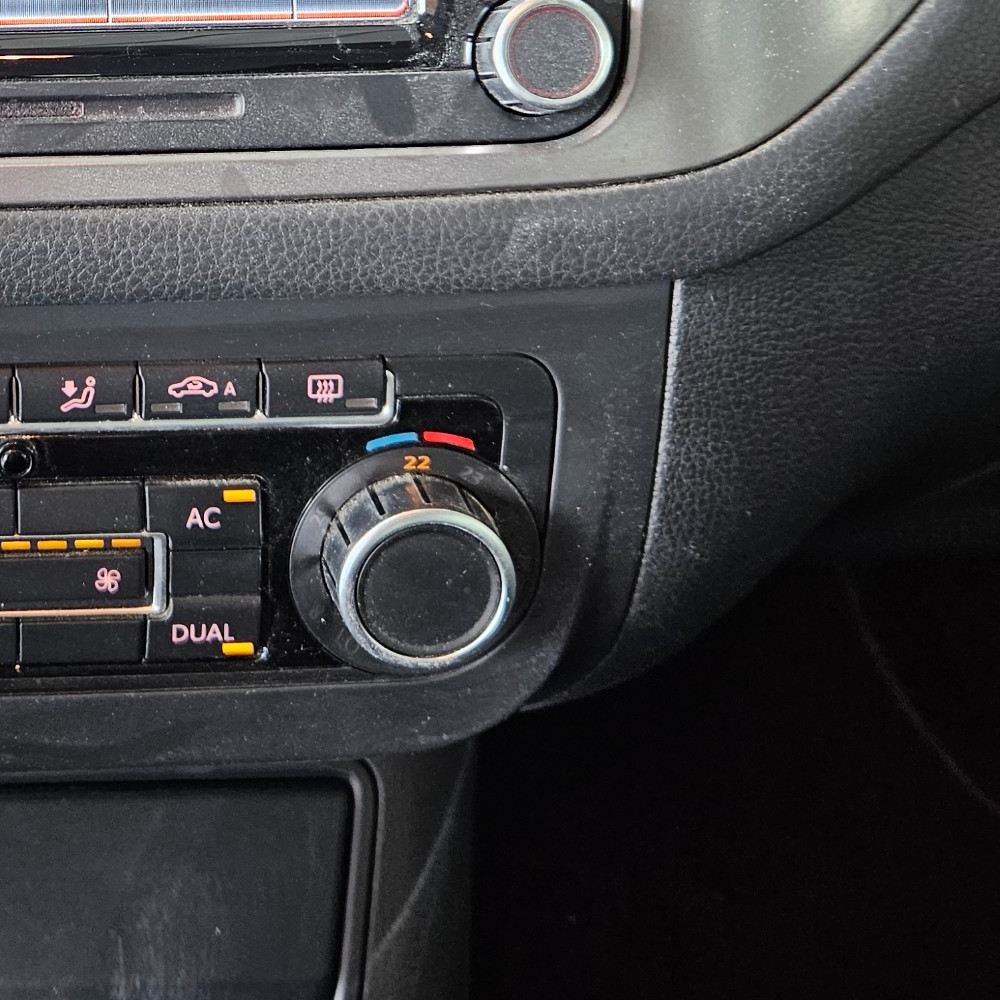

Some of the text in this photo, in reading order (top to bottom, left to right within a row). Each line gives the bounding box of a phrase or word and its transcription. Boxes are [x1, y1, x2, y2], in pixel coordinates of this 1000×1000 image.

[223, 381, 236, 397] A
[403, 455, 431, 470] 22
[185, 506, 222, 530] AC
[171, 622, 235, 644] DUAL
